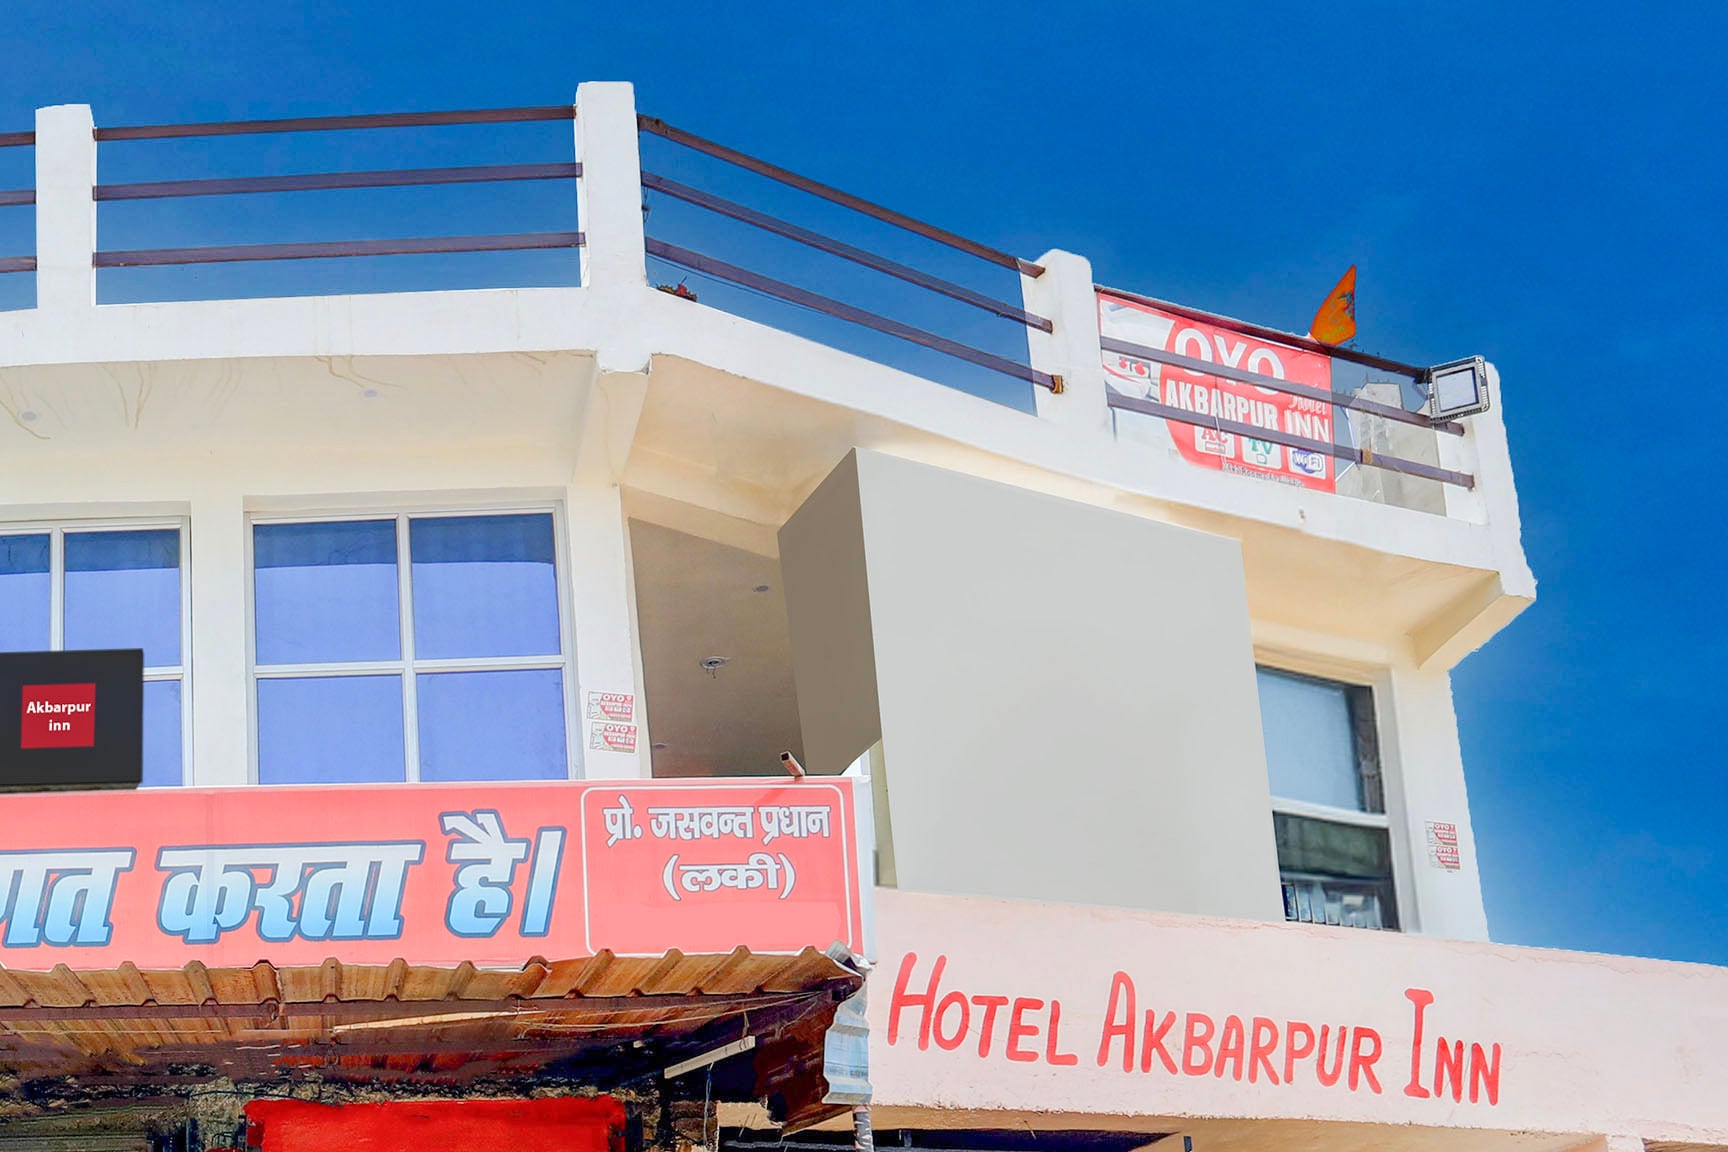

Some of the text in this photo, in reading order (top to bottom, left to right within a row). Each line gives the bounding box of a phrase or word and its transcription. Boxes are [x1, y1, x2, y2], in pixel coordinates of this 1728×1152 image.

[1166, 378, 1330, 444] AKBARPUR INN
[26, 700, 92, 716] Akbarpur
[603, 694, 625, 703] OYO
[48, 719, 72, 732] inn
[606, 724, 629, 733] OYO
[602, 794, 832, 848] प्रो. जसवन्त प्रधान
[155, 840, 426, 945] करता
[662, 852, 797, 902] (लकी)
[888, 952, 1503, 1107] HOTEL AKBARPUR INN
